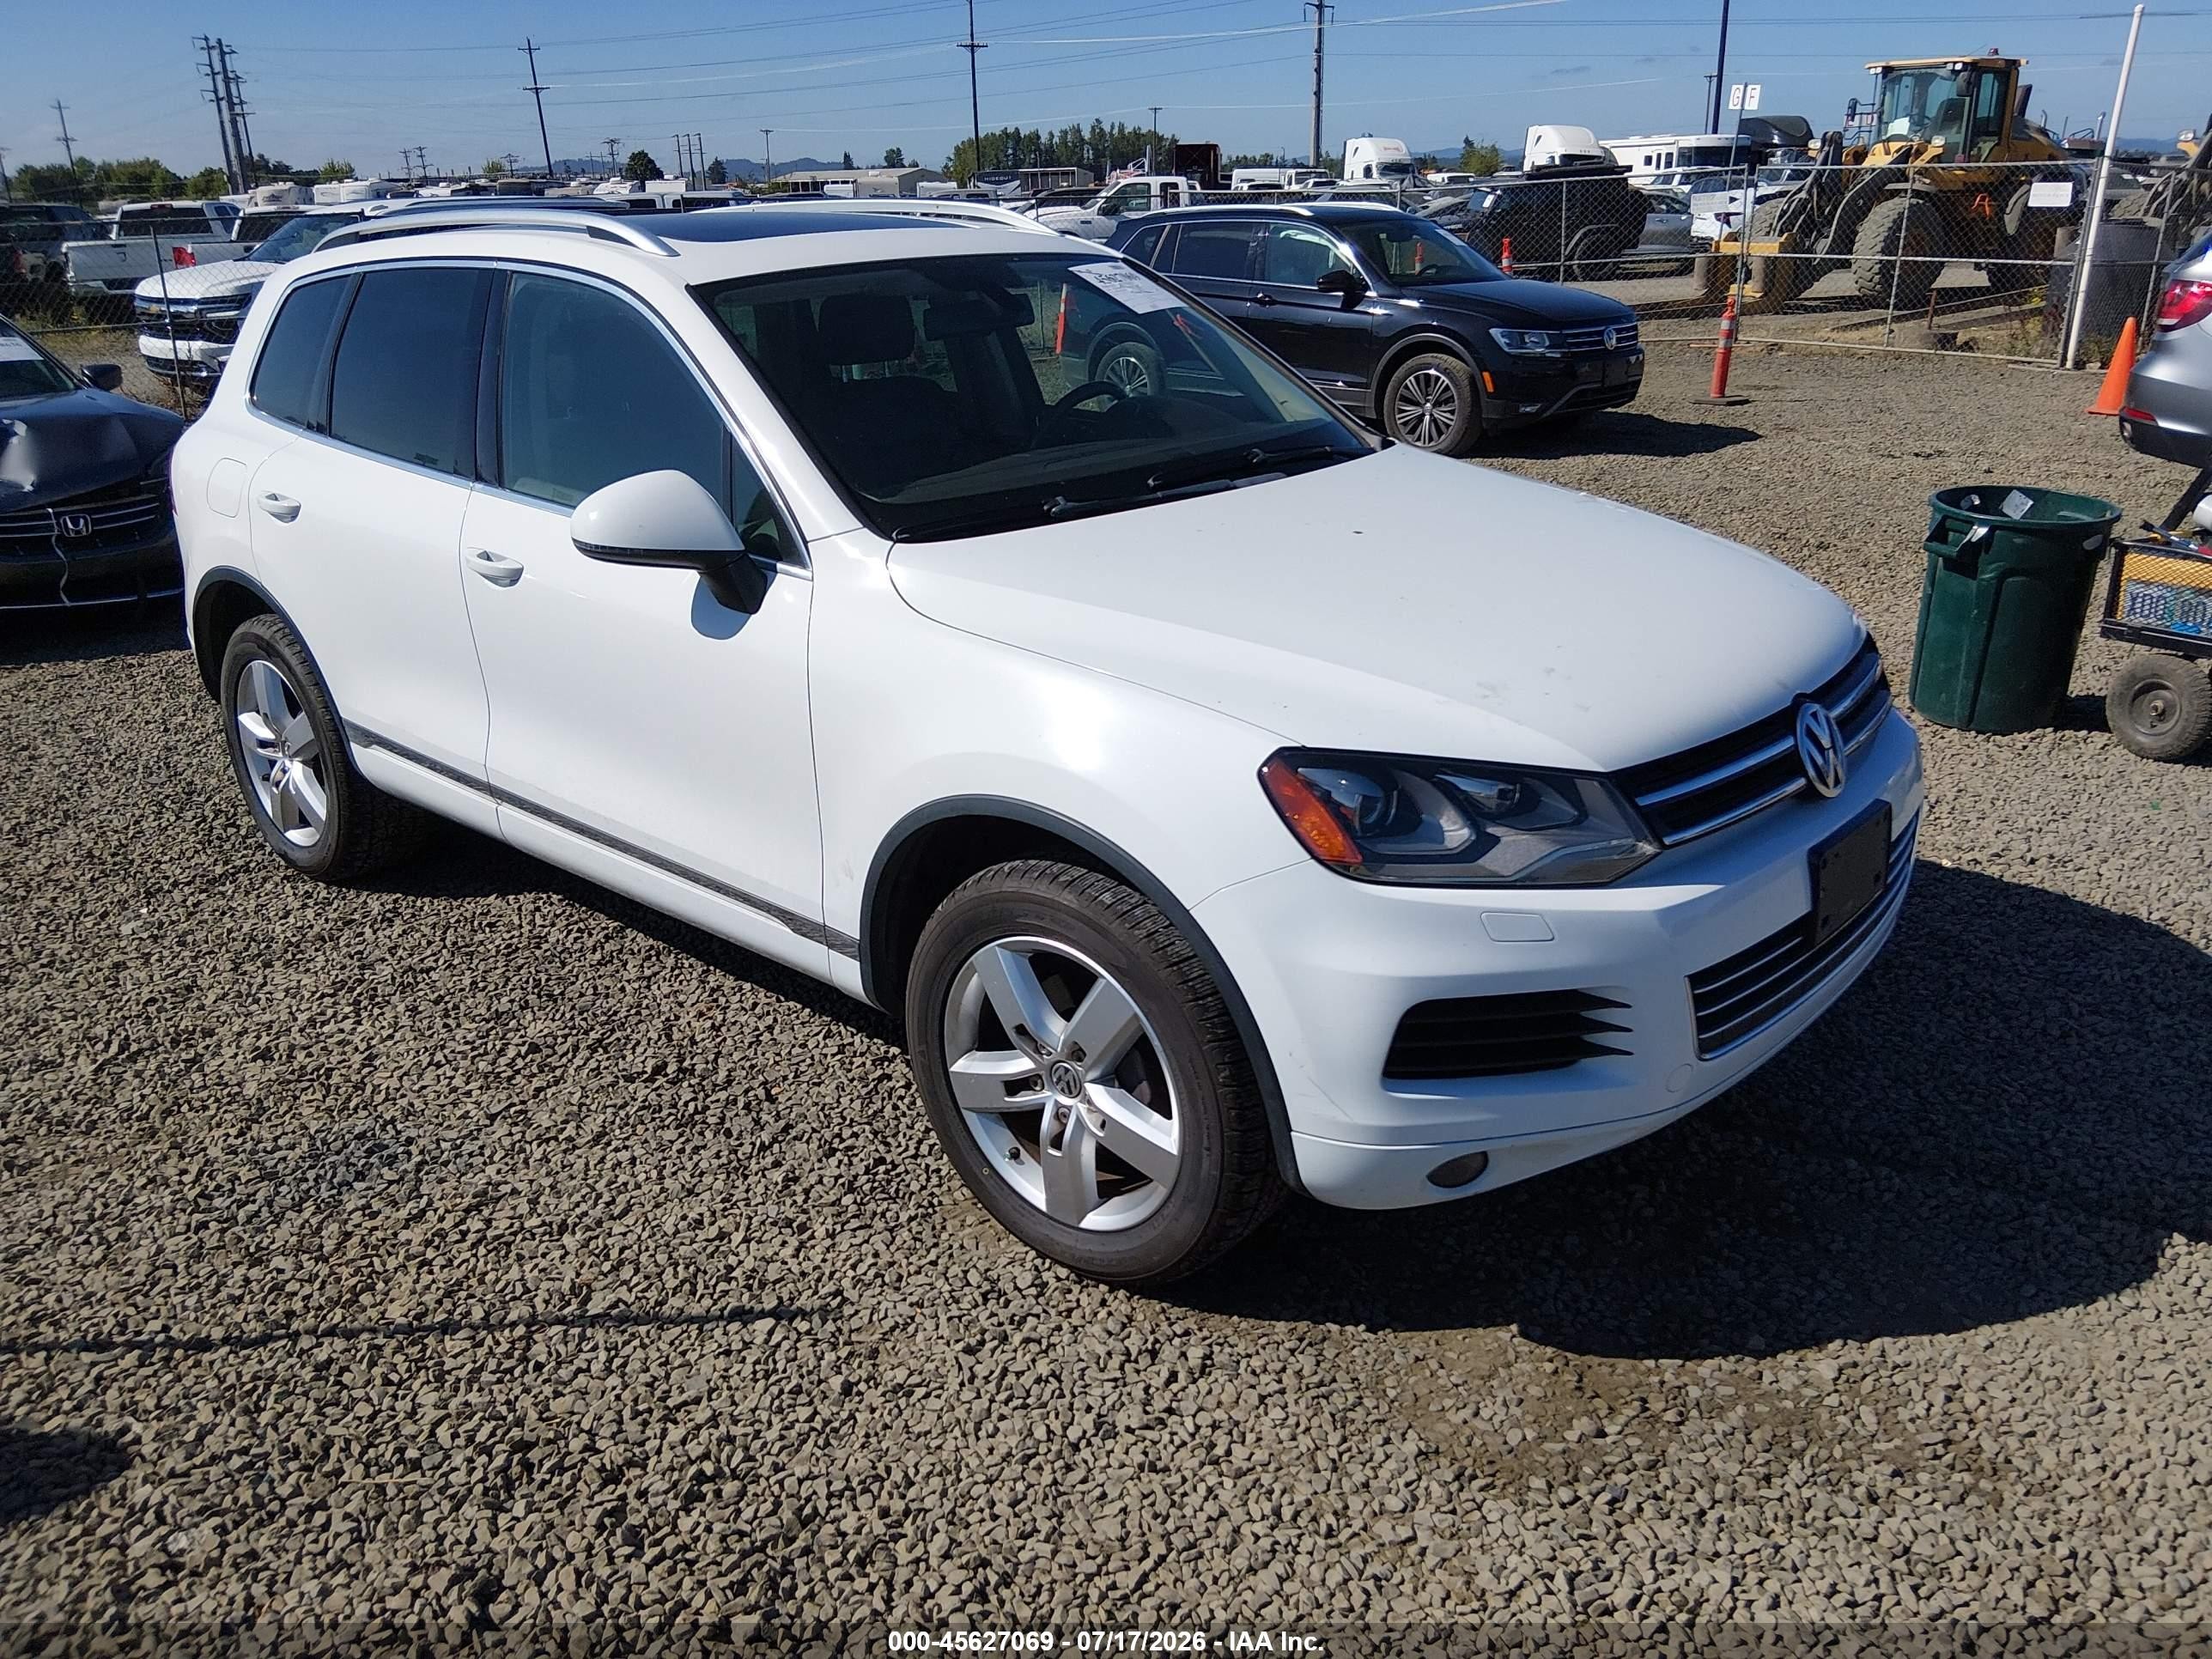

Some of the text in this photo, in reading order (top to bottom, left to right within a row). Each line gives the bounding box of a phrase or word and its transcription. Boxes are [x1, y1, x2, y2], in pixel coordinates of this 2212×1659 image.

[1732, 87, 1741, 106] G
[1748, 87, 1758, 106] F
[1796, 702, 1846, 798] VW
